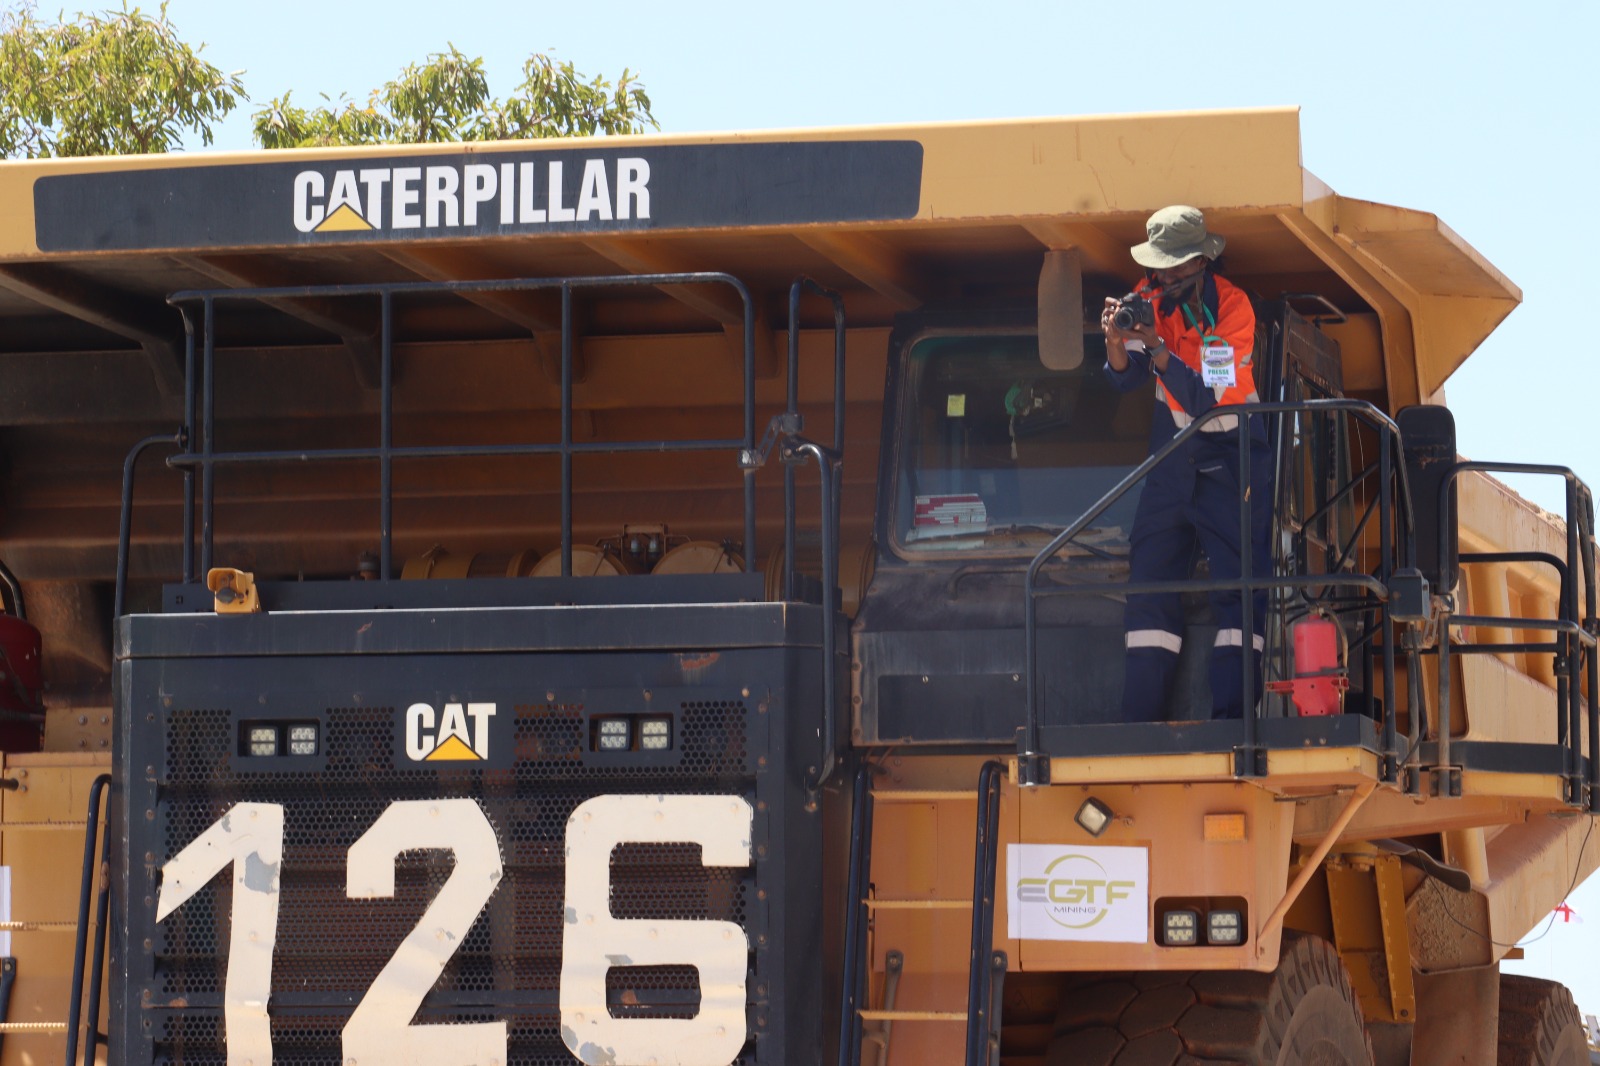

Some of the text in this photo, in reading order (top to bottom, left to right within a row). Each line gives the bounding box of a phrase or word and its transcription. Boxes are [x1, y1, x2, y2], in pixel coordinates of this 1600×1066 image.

[294, 157, 651, 232] CATERPILLAR
[406, 702, 497, 761] CAT
[1017, 878, 1136, 905] EGTF
[1053, 906, 1096, 914] MINING
[155, 794, 754, 1066] 126
